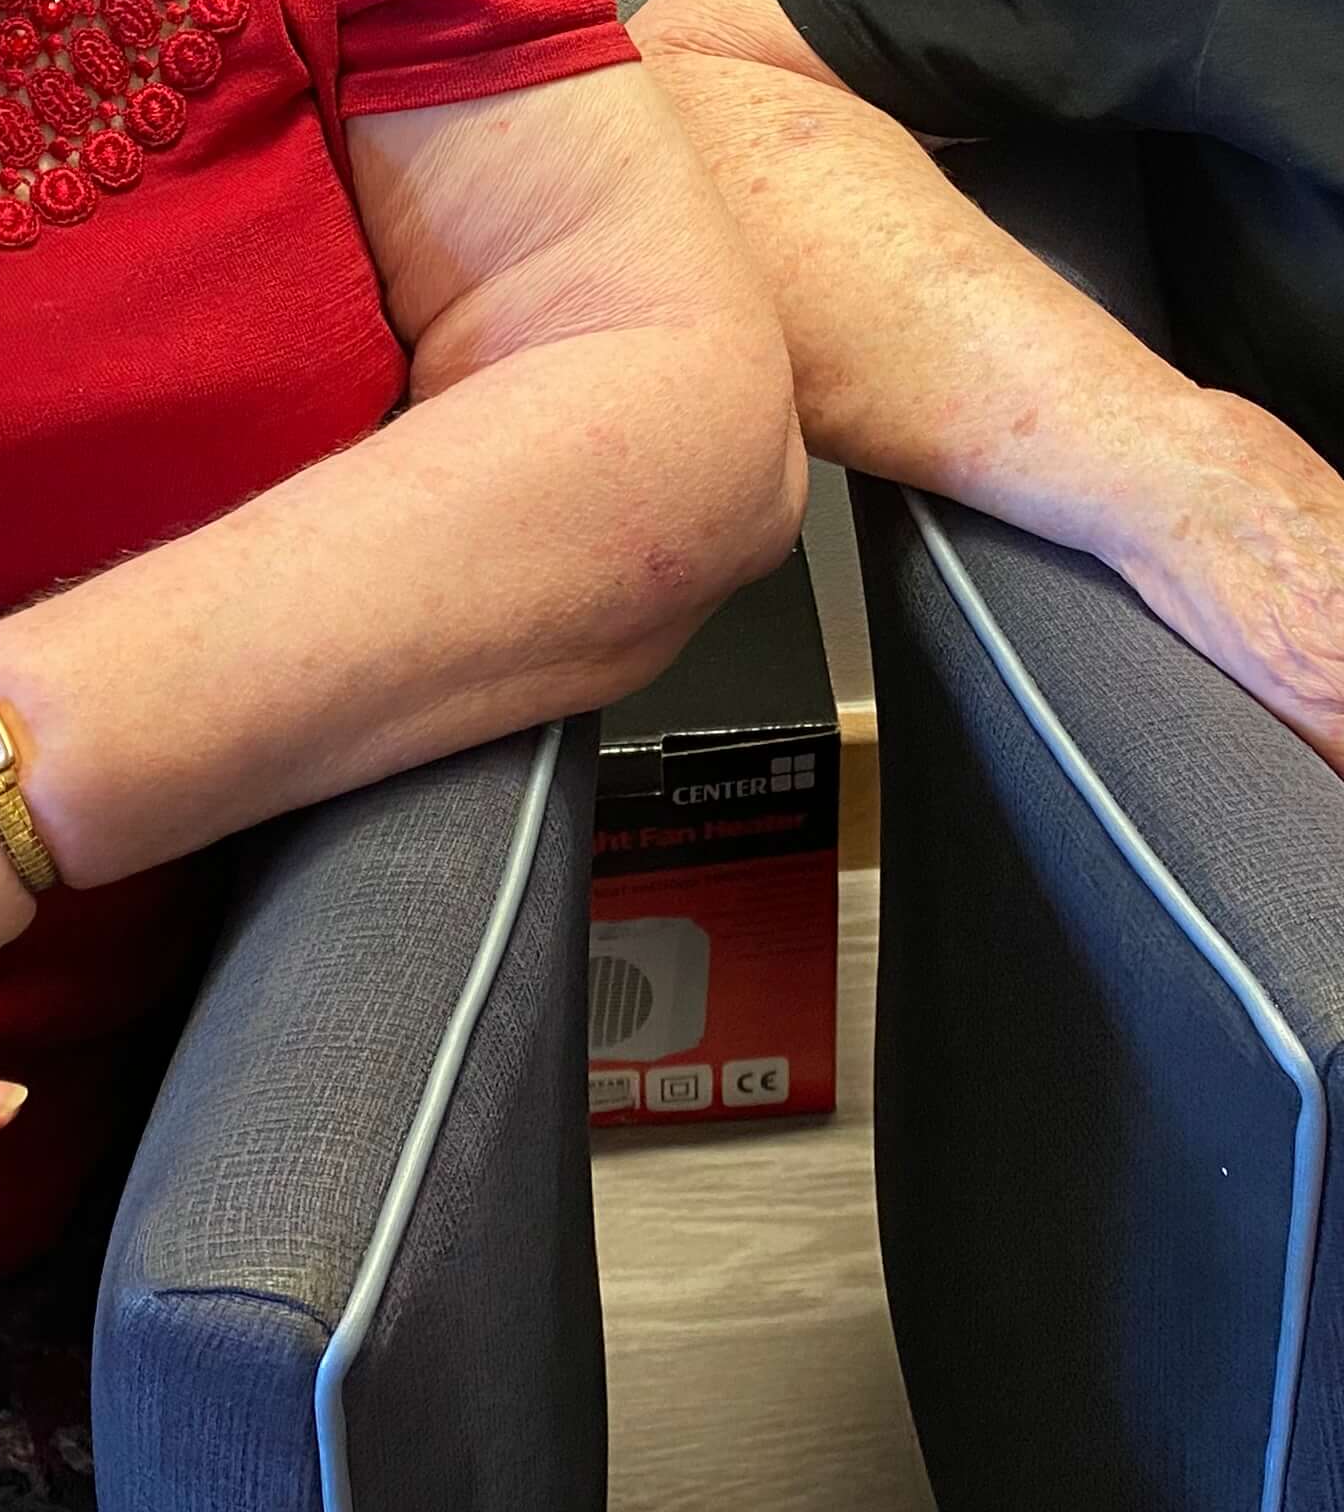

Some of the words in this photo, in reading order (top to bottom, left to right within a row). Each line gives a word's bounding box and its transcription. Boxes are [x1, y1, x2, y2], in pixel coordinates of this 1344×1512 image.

[672, 776, 768, 806] CENTER
[639, 826, 697, 851] Fan
[704, 814, 806, 840] Heater
